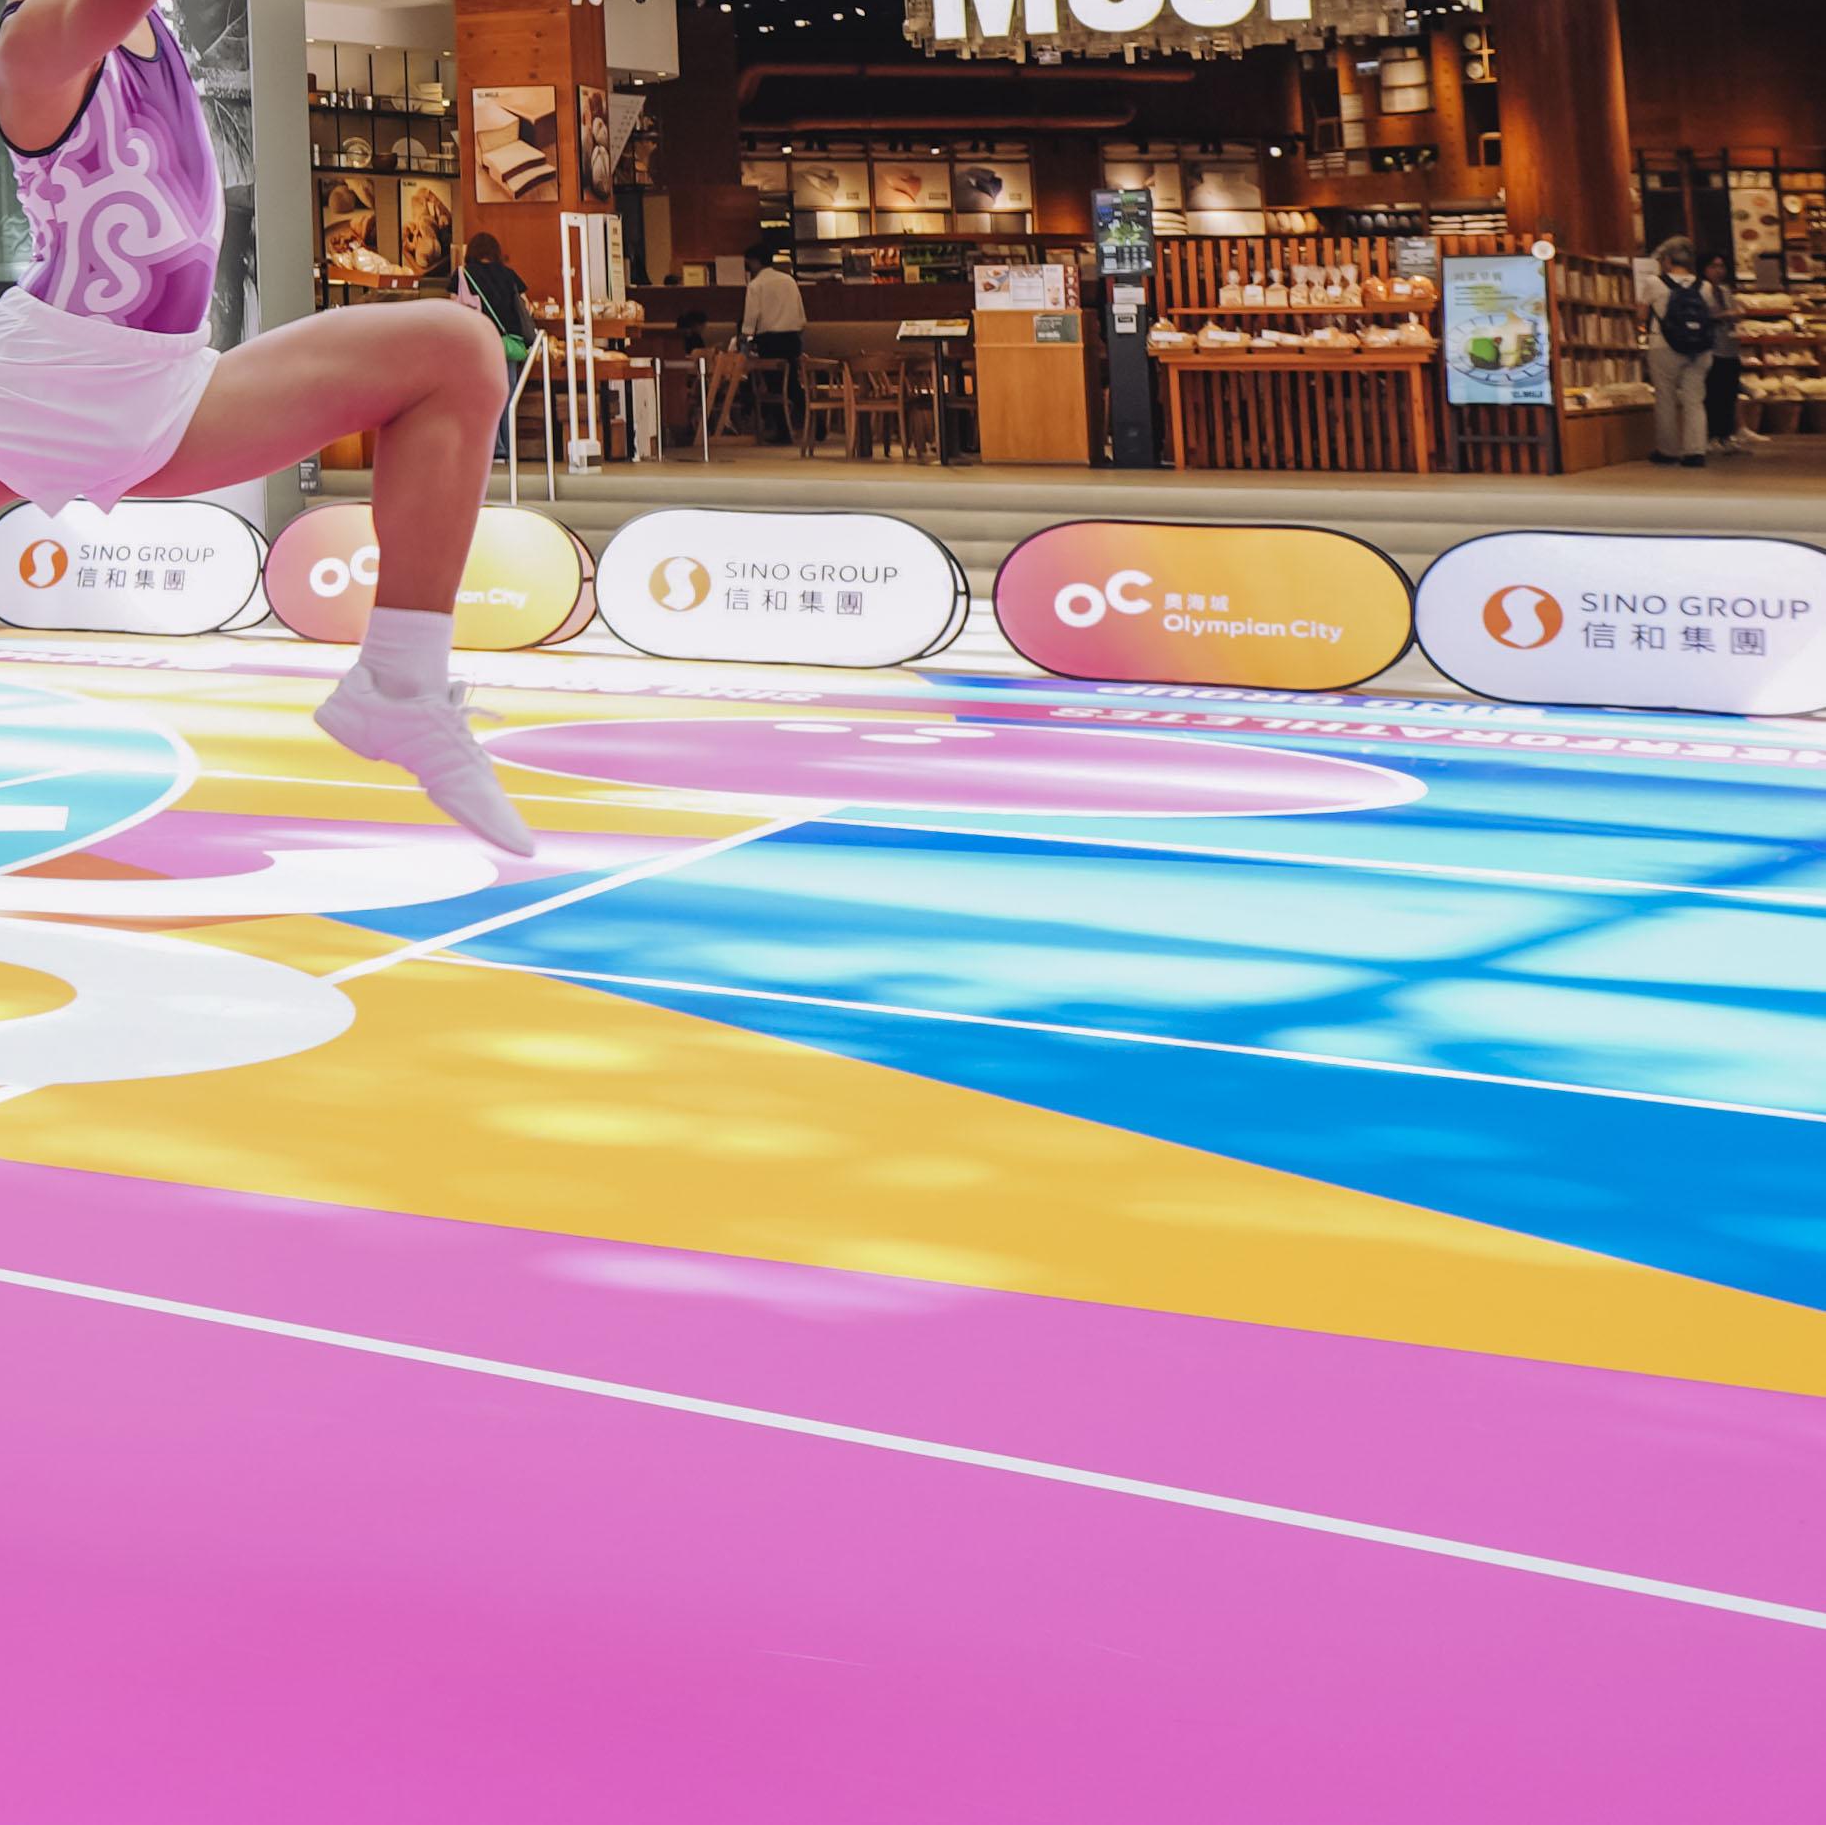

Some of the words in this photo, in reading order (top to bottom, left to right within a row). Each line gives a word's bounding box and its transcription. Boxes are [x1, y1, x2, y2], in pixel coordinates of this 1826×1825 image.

[79, 544, 132, 562] SINO
[137, 545, 215, 564] GROUP
[77, 566, 186, 591] 信和集團
[725, 560, 791, 582] SINO
[799, 562, 900, 584] GROUP
[488, 587, 527, 608] City
[725, 587, 864, 616] 信和集團
[1580, 591, 1668, 615] SINO
[1679, 595, 1812, 621] GROUP
[1163, 612, 1287, 639] Olympian
[1290, 620, 1344, 644] City
[1580, 621, 1768, 657] 信和集團
[1095, 685, 1344, 706] GROUP
[1051, 706, 1445, 741] ATHLETES
